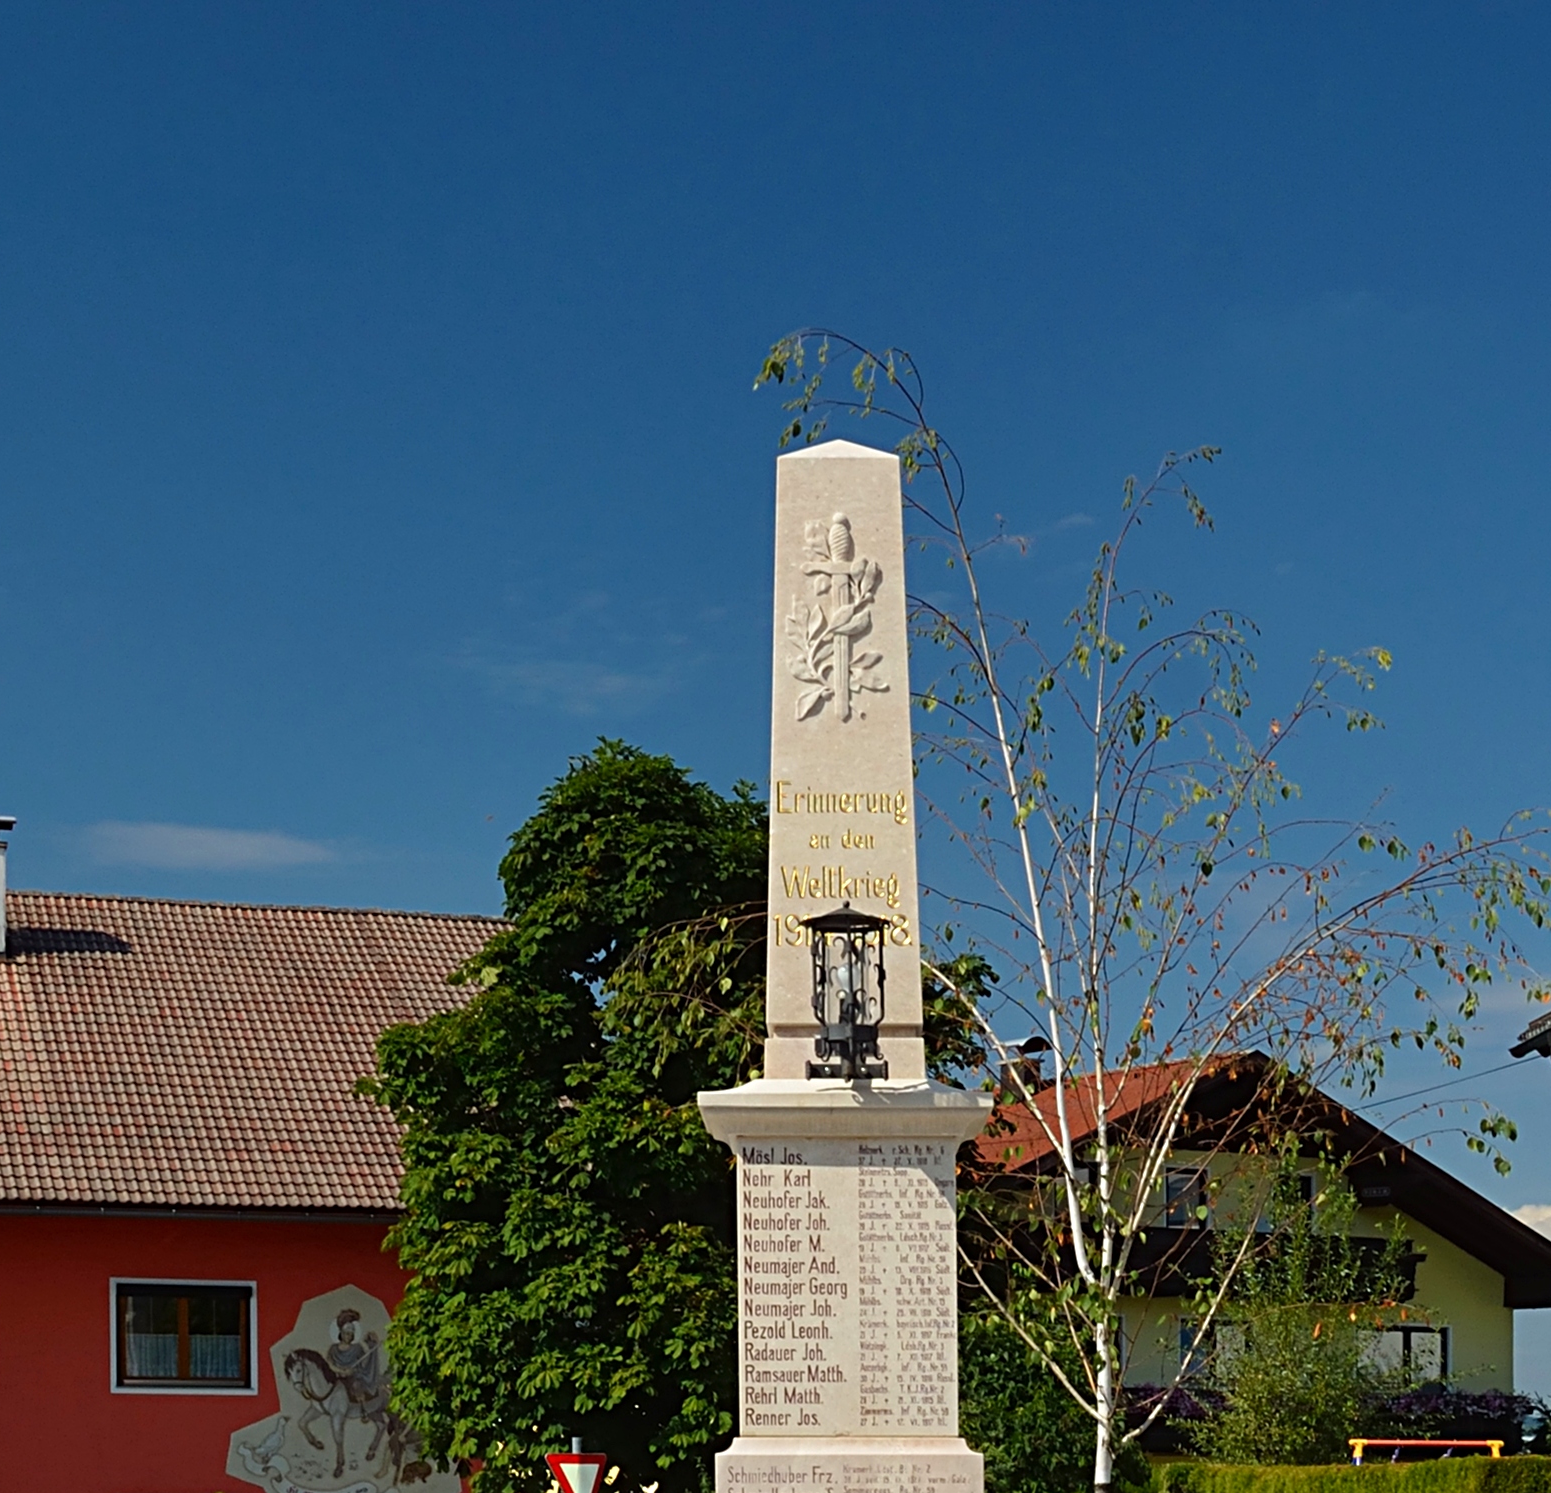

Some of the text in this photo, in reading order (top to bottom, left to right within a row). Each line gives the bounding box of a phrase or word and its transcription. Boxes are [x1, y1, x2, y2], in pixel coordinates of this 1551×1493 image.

[776, 781, 908, 824] Erinnerung
[809, 829, 875, 849] an den
[781, 866, 900, 908] Weltkrieg
[743, 1148, 807, 1165] Mösl Jos.
[743, 1169, 811, 1187] Nehr Karl
[743, 1191, 830, 1209] Neuhofer Jak.
[743, 1213, 830, 1231] Neuhofer Joh.
[743, 1235, 825, 1252] Neuhofer M.
[743, 1256, 840, 1277] Neumajer And.
[744, 1278, 848, 1299] Neumajer Georg
[744, 1300, 836, 1320] Neumajer Joh.
[744, 1321, 833, 1339] Pezold Leonh.
[745, 1343, 827, 1361] Radauer Joh.
[745, 1364, 847, 1383] Ramsauer Matth.
[745, 1386, 777, 1404] Rehrl
[746, 1408, 821, 1426] Renner Jos.
[727, 1466, 807, 1483] Schmiedhuber
[812, 1467, 838, 1484] Frz.
